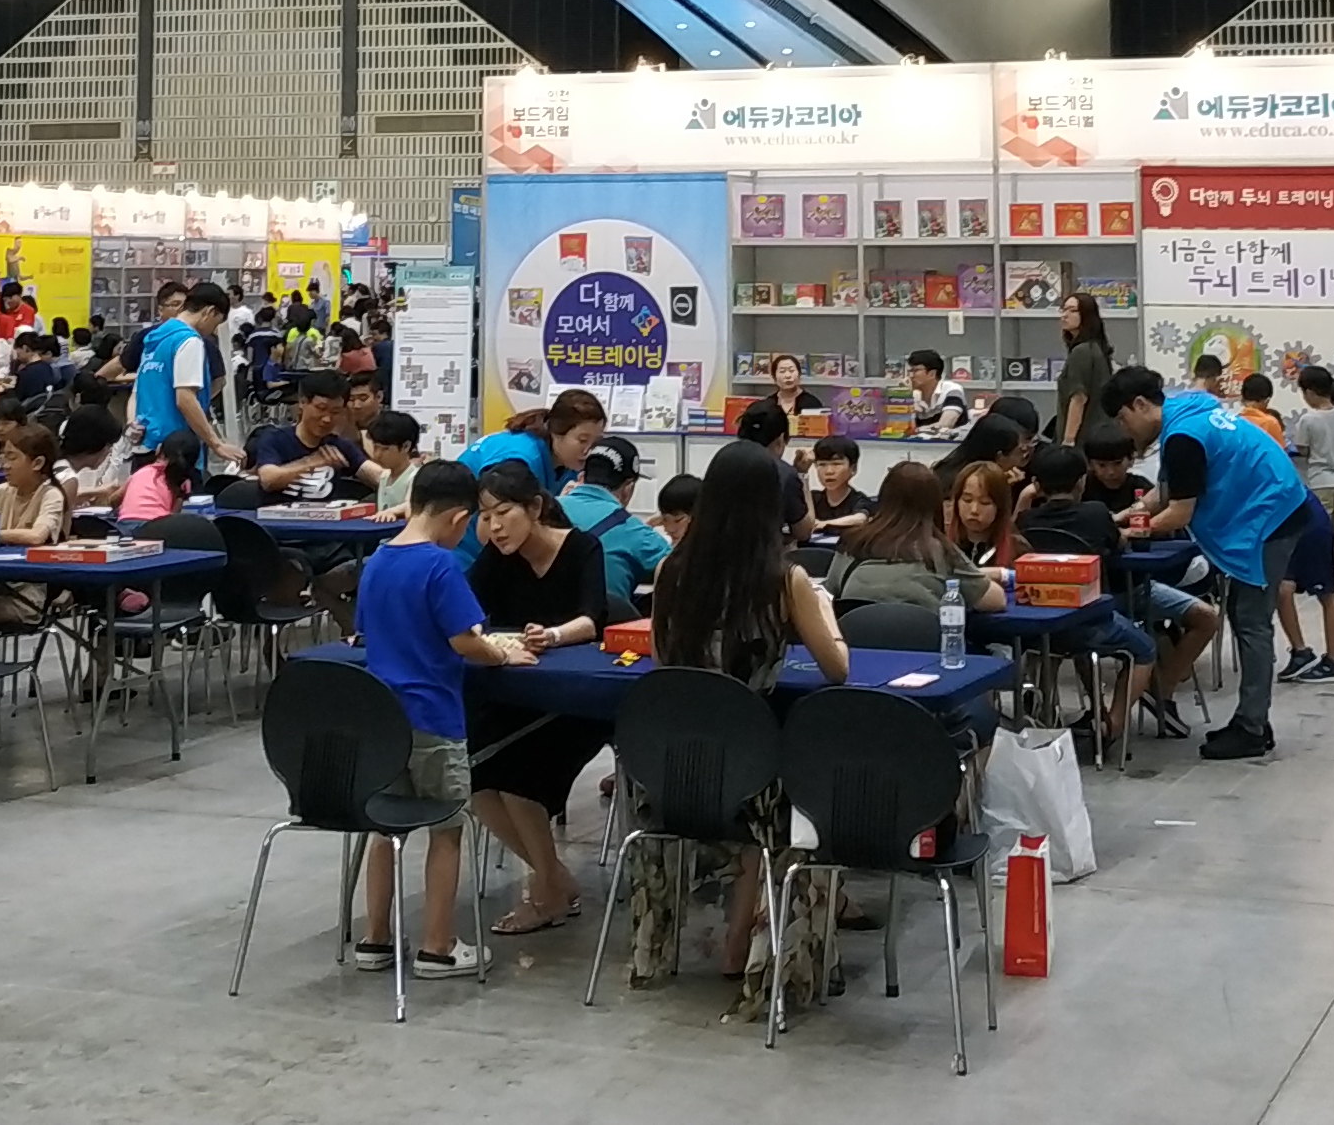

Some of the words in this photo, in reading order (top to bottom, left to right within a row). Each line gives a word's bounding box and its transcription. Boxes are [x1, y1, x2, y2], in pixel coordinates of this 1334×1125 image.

[1027, 94, 1093, 111] 보드게임
[513, 106, 569, 121] 보드게임
[722, 104, 862, 129] 에듀카코리아
[1042, 115, 1094, 128] 페스티벌
[525, 125, 569, 137] 페스티벌
[724, 130, 859, 146] www.educa.co.kr
[1189, 187, 1234, 207] 다함께
[1239, 187, 1271, 206] 두뇌
[1276, 189, 1334, 208] 트레이닝
[1160, 238, 1217, 264] 지금은
[1225, 239, 1292, 265] 다함께
[1188, 265, 1238, 298] 두뇌
[556, 315, 611, 336] 모여서
[546, 344, 663, 369] 두뇌트레이닝
